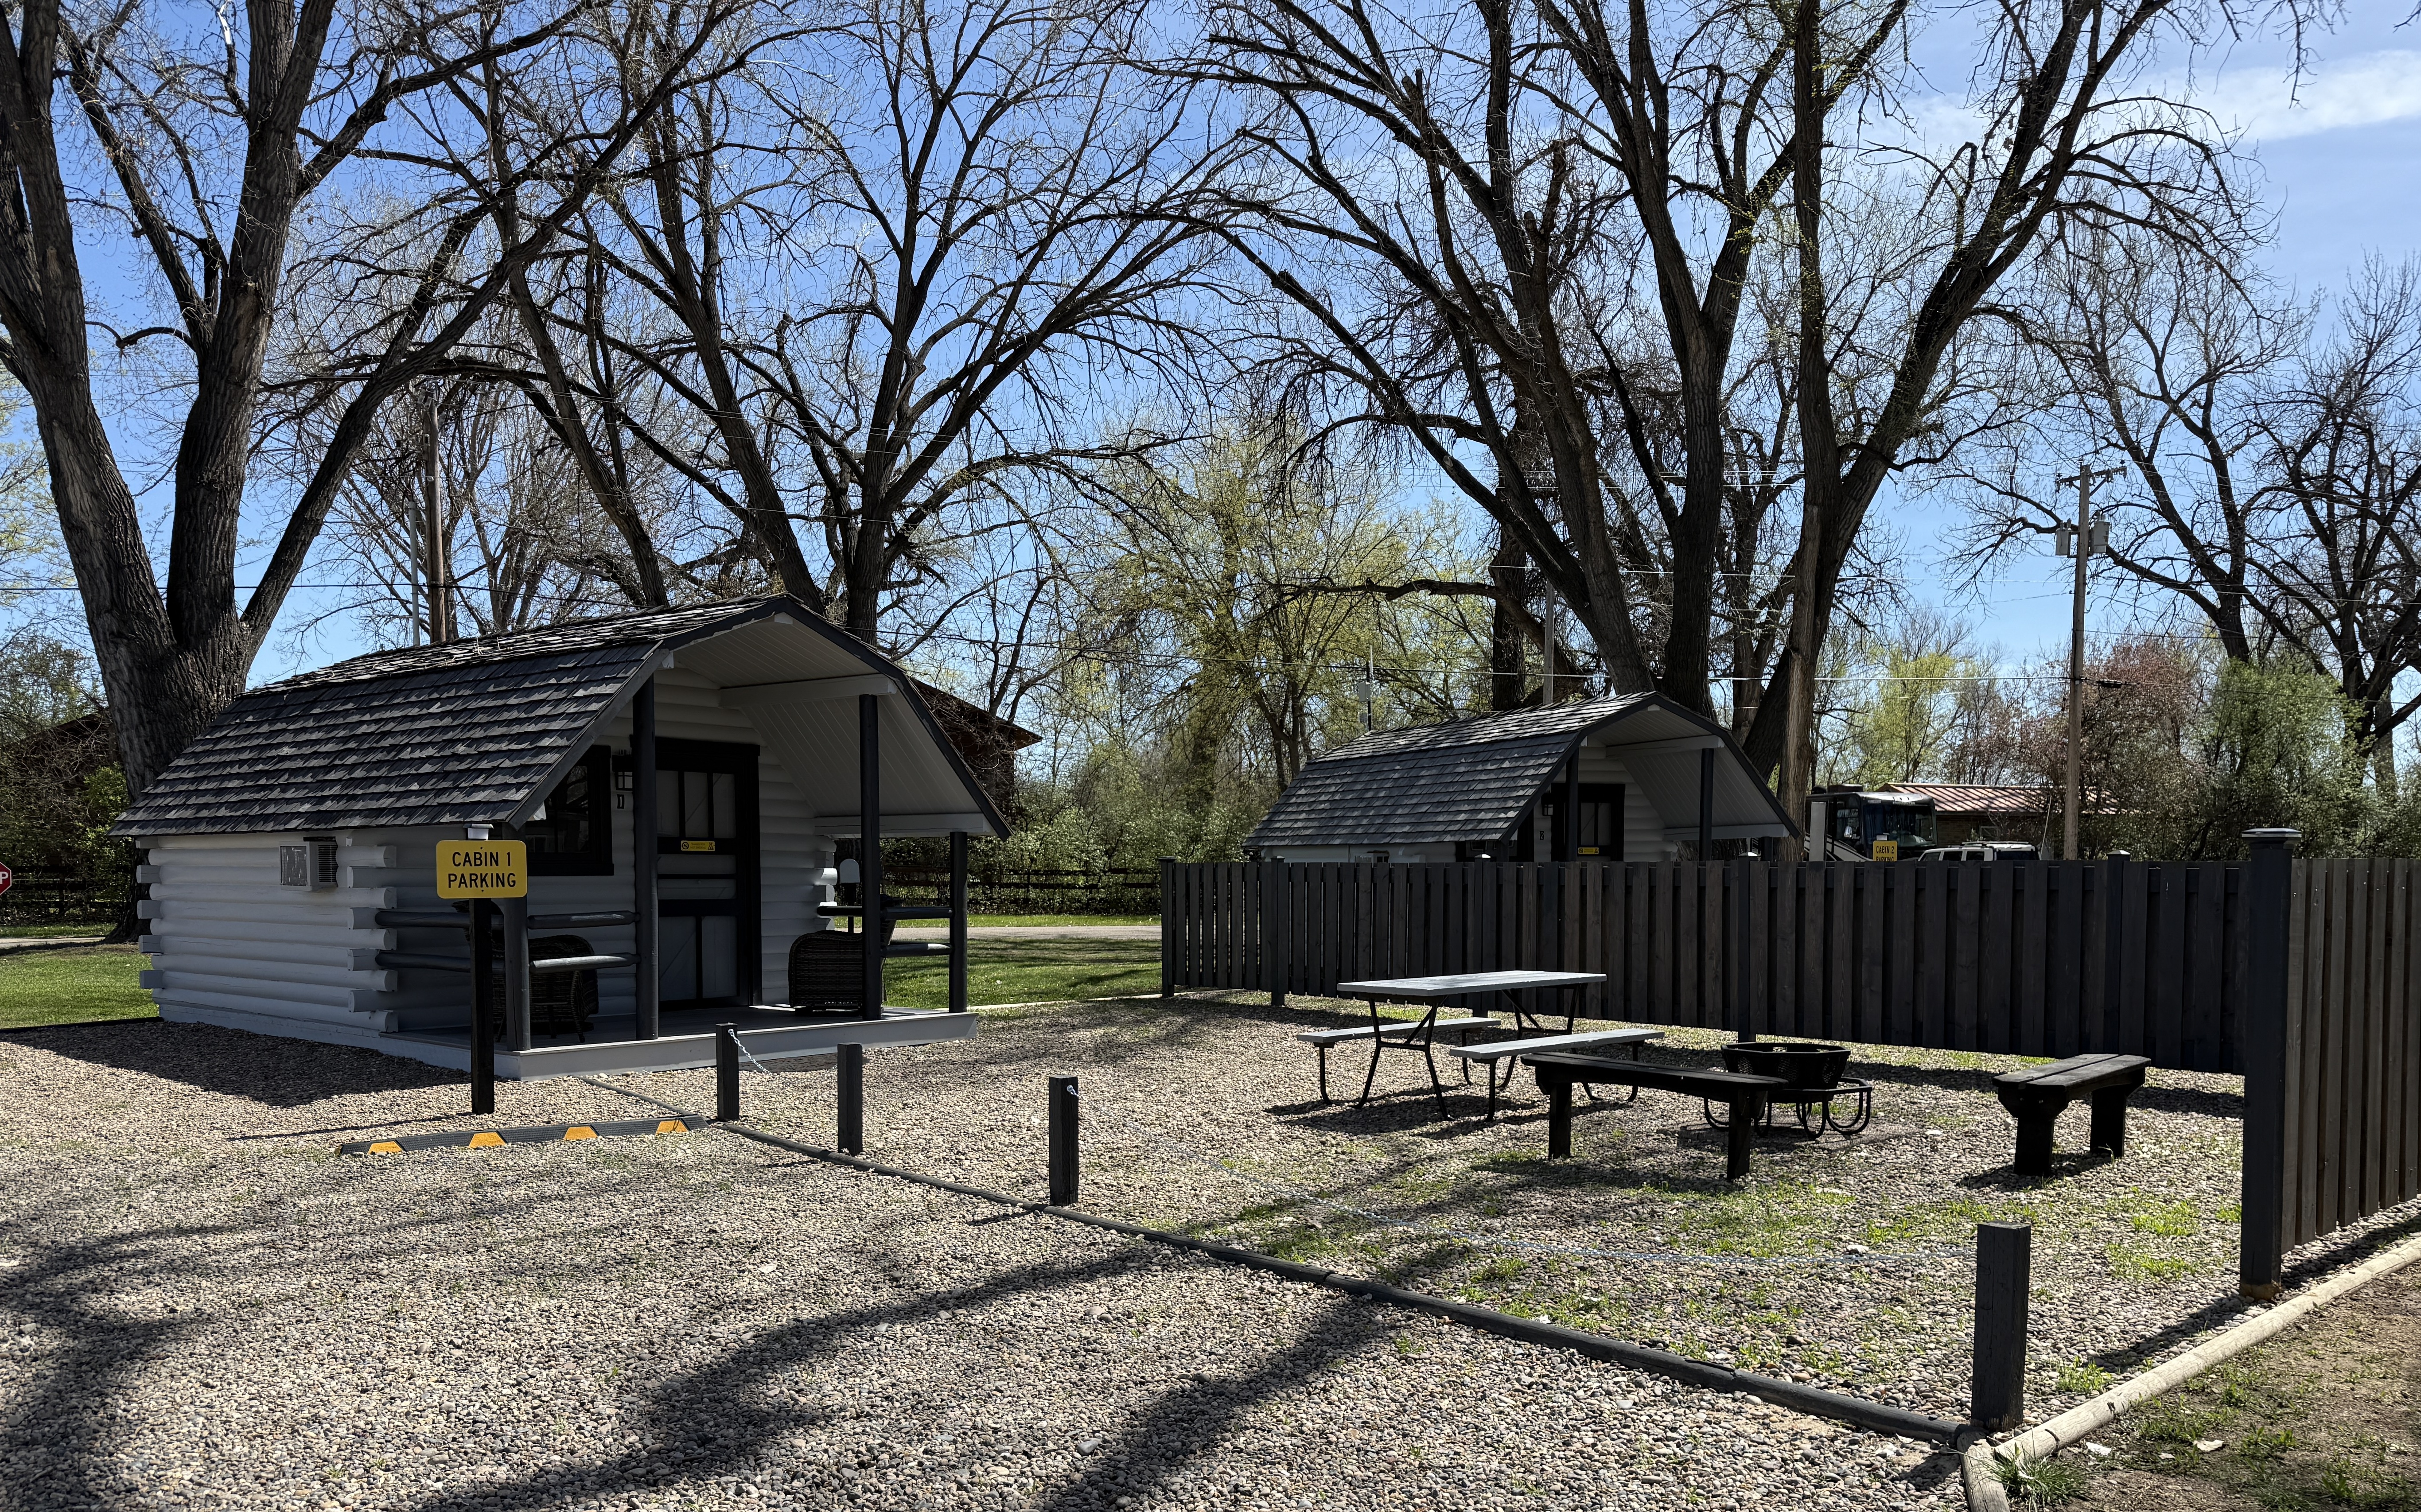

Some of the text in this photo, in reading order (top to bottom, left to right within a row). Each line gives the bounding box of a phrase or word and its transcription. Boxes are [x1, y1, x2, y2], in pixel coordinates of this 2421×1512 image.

[619, 796, 623, 807] 1
[452, 851, 511, 867] CABIN 1
[448, 872, 516, 888] PARKING
